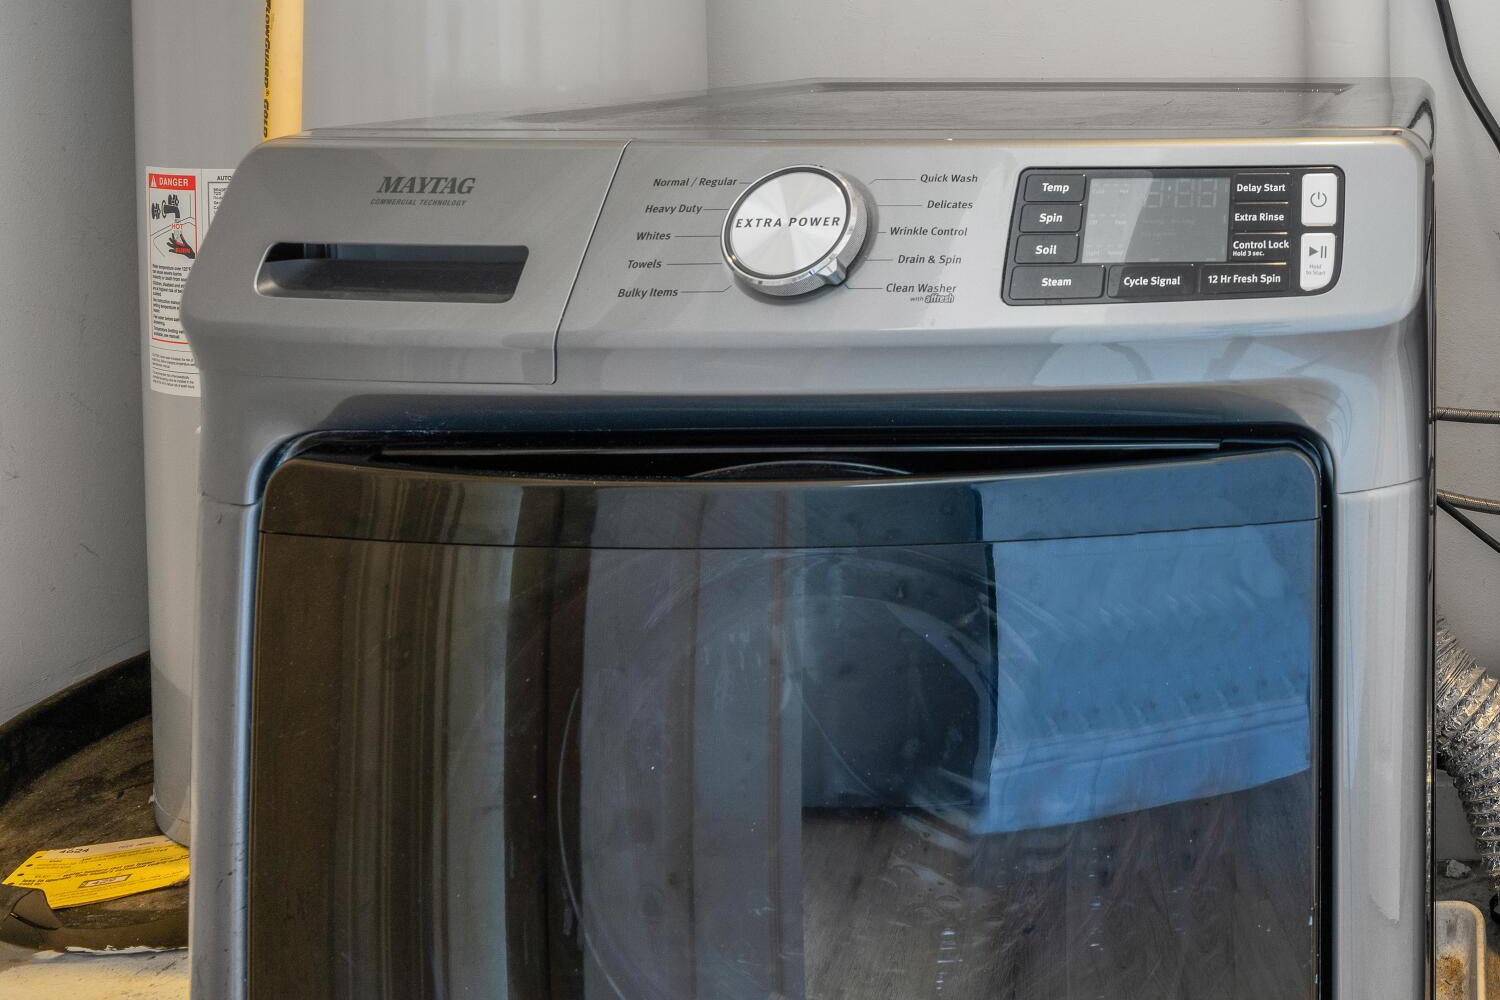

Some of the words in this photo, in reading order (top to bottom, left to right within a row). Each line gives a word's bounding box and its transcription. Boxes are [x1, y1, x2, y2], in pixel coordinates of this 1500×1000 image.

[159, 178, 189, 187] DANGER
[653, 178, 688, 187] Normal
[698, 177, 738, 189] Regular
[920, 173, 948, 184] Quick
[950, 173, 978, 183] Wash
[376, 176, 476, 194] MAYTAG
[1042, 182, 1070, 194] Temp
[1236, 183, 1261, 194] Delay
[1263, 183, 1287, 193] Start
[370, 198, 416, 206] COMMERCIAL
[927, 199, 974, 209] Delicates
[645, 204, 677, 216] Heavy
[678, 204, 703, 216] Duty
[735, 217, 783, 229] EXTRA
[788, 216, 842, 228] POWER
[1039, 212, 1063, 225] Spin
[1234, 212, 1256, 222] Extra
[1258, 212, 1285, 222] Rinse
[636, 231, 671, 241] Whites
[890, 226, 929, 237] Wrinkle
[930, 226, 968, 237] Control
[1035, 244, 1057, 255] Soil
[1232, 240, 1265, 250] Control
[1266, 240, 1290, 250] Lock
[627, 259, 662, 269] Towels
[897, 254, 926, 264] Drain
[928, 255, 937, 264] &
[938, 254, 962, 266] Spin
[1041, 276, 1072, 287] Steam
[1123, 276, 1149, 287] Cycle
[1150, 276, 1181, 288] Signal
[1207, 275, 1218, 284] 12
[1219, 274, 1231, 284] Hr
[1233, 273, 1257, 284] Fresh
[1258, 274, 1282, 286] Spin
[617, 288, 648, 299] Bulky
[649, 287, 678, 297] Items
[886, 283, 914, 293] Clean
[916, 283, 957, 294] Washer
